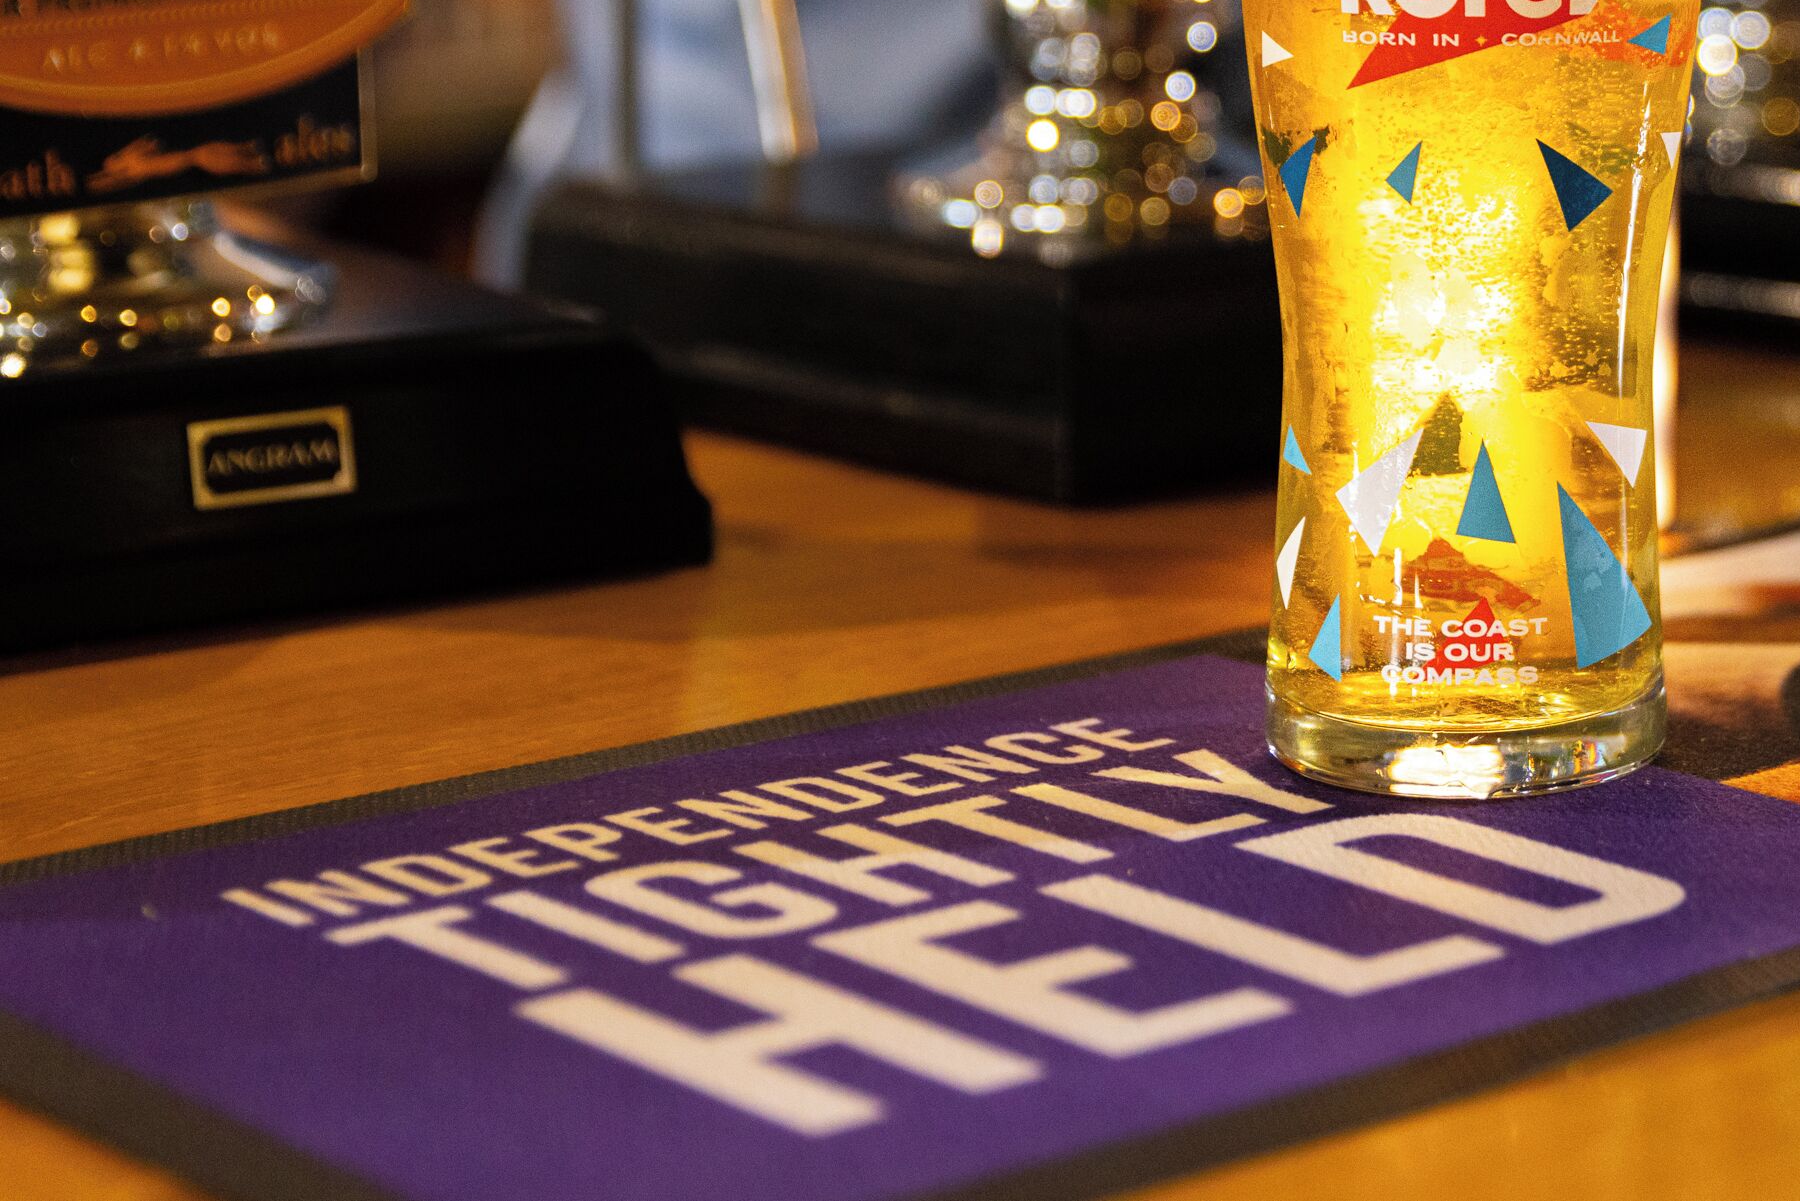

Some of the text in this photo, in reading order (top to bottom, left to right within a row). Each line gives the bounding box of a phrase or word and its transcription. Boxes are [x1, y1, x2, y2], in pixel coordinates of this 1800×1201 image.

[1342, 30, 1621, 47] BORN IN CORNWALL
[207, 438, 336, 475] ANGRAM
[1373, 615, 1548, 638] THE COAST
[1405, 642, 1515, 662] IS OUR
[1381, 664, 1540, 686] COMPASS
[220, 716, 1178, 928] INDEPENDENCE
[322, 748, 1336, 990] TIGHTLY
[512, 812, 1688, 1138] HELD
